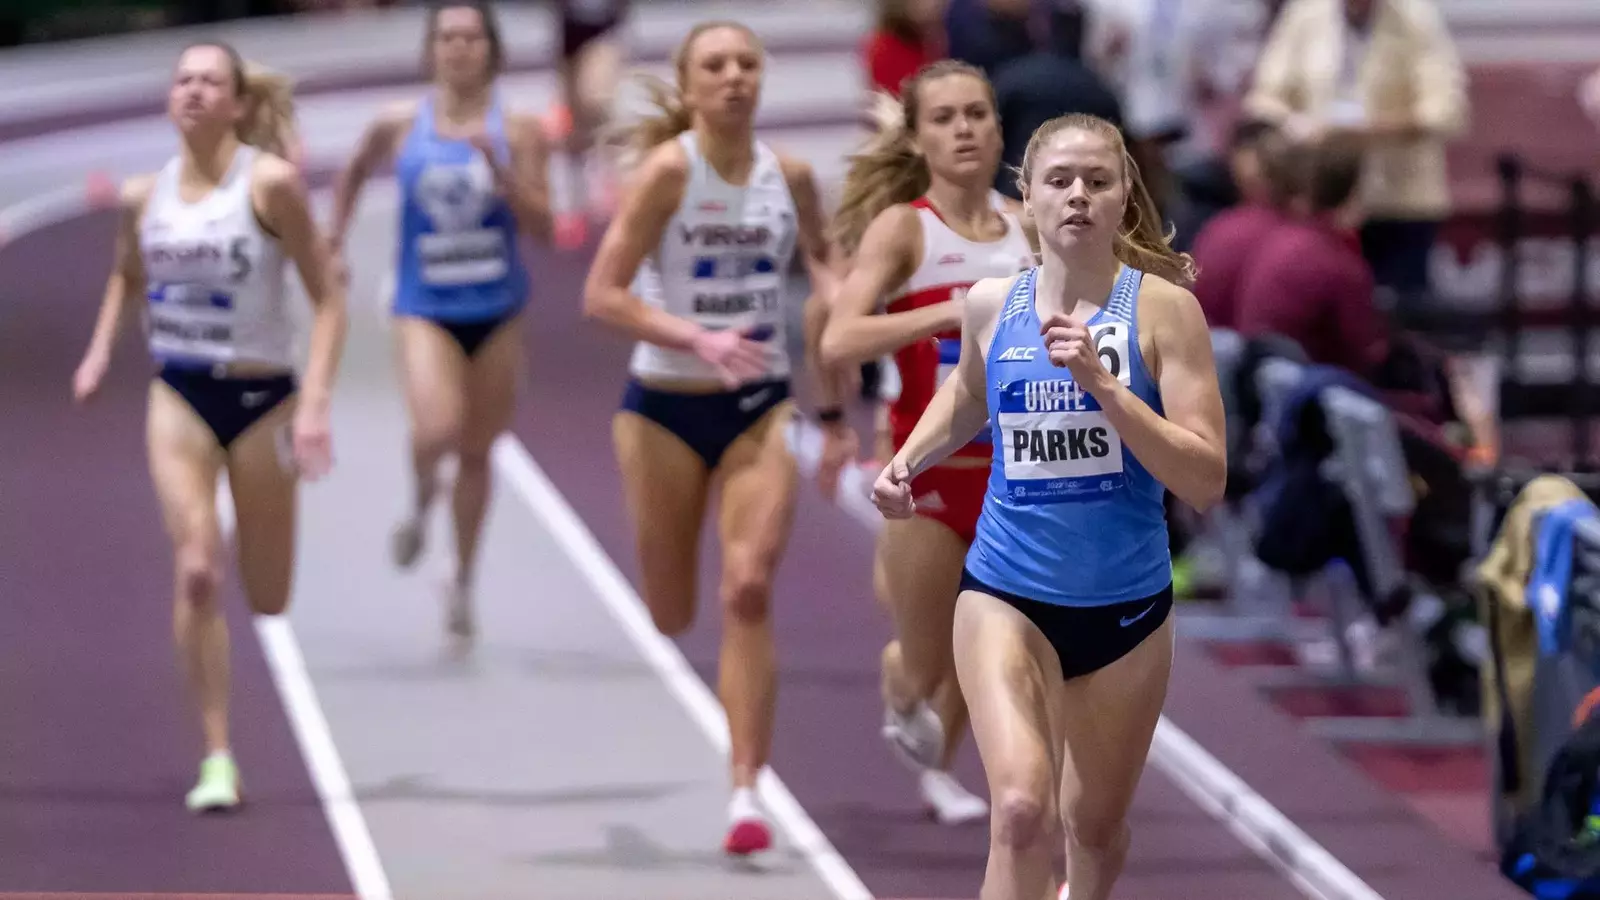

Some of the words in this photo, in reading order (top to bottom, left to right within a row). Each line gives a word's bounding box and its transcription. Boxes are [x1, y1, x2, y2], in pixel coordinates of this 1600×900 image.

[998, 346, 1039, 360] ACC
[1094, 326, 1120, 378] 6
[1025, 380, 1086, 411] UNITE
[1013, 427, 1110, 462] PARKS
